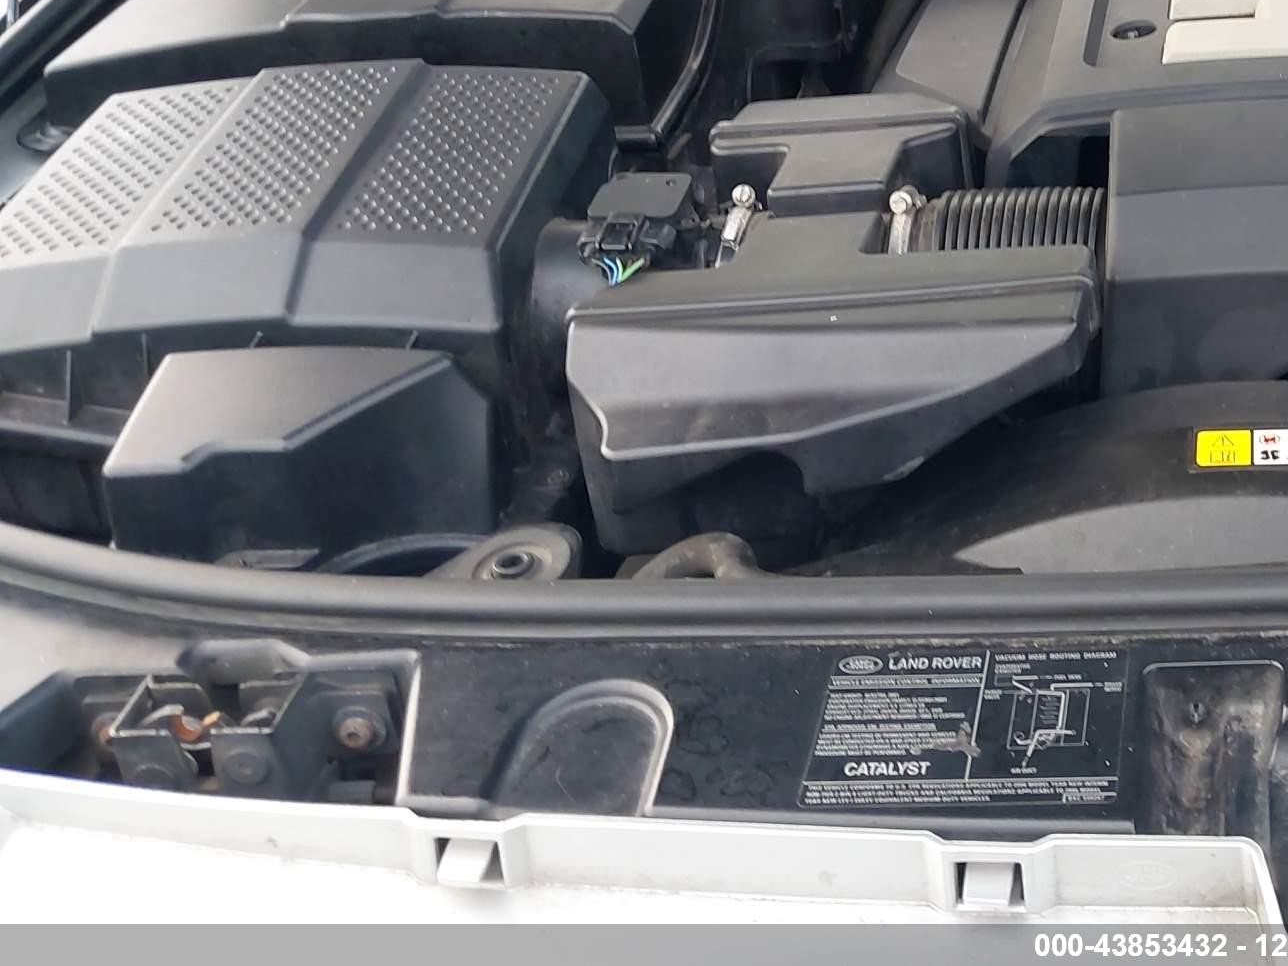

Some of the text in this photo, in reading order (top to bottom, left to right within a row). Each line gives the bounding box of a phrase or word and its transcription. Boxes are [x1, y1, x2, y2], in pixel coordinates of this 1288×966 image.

[888, 656, 929, 671] LAND
[931, 656, 982, 670] ROVER
[844, 761, 931, 776] CATALYST
